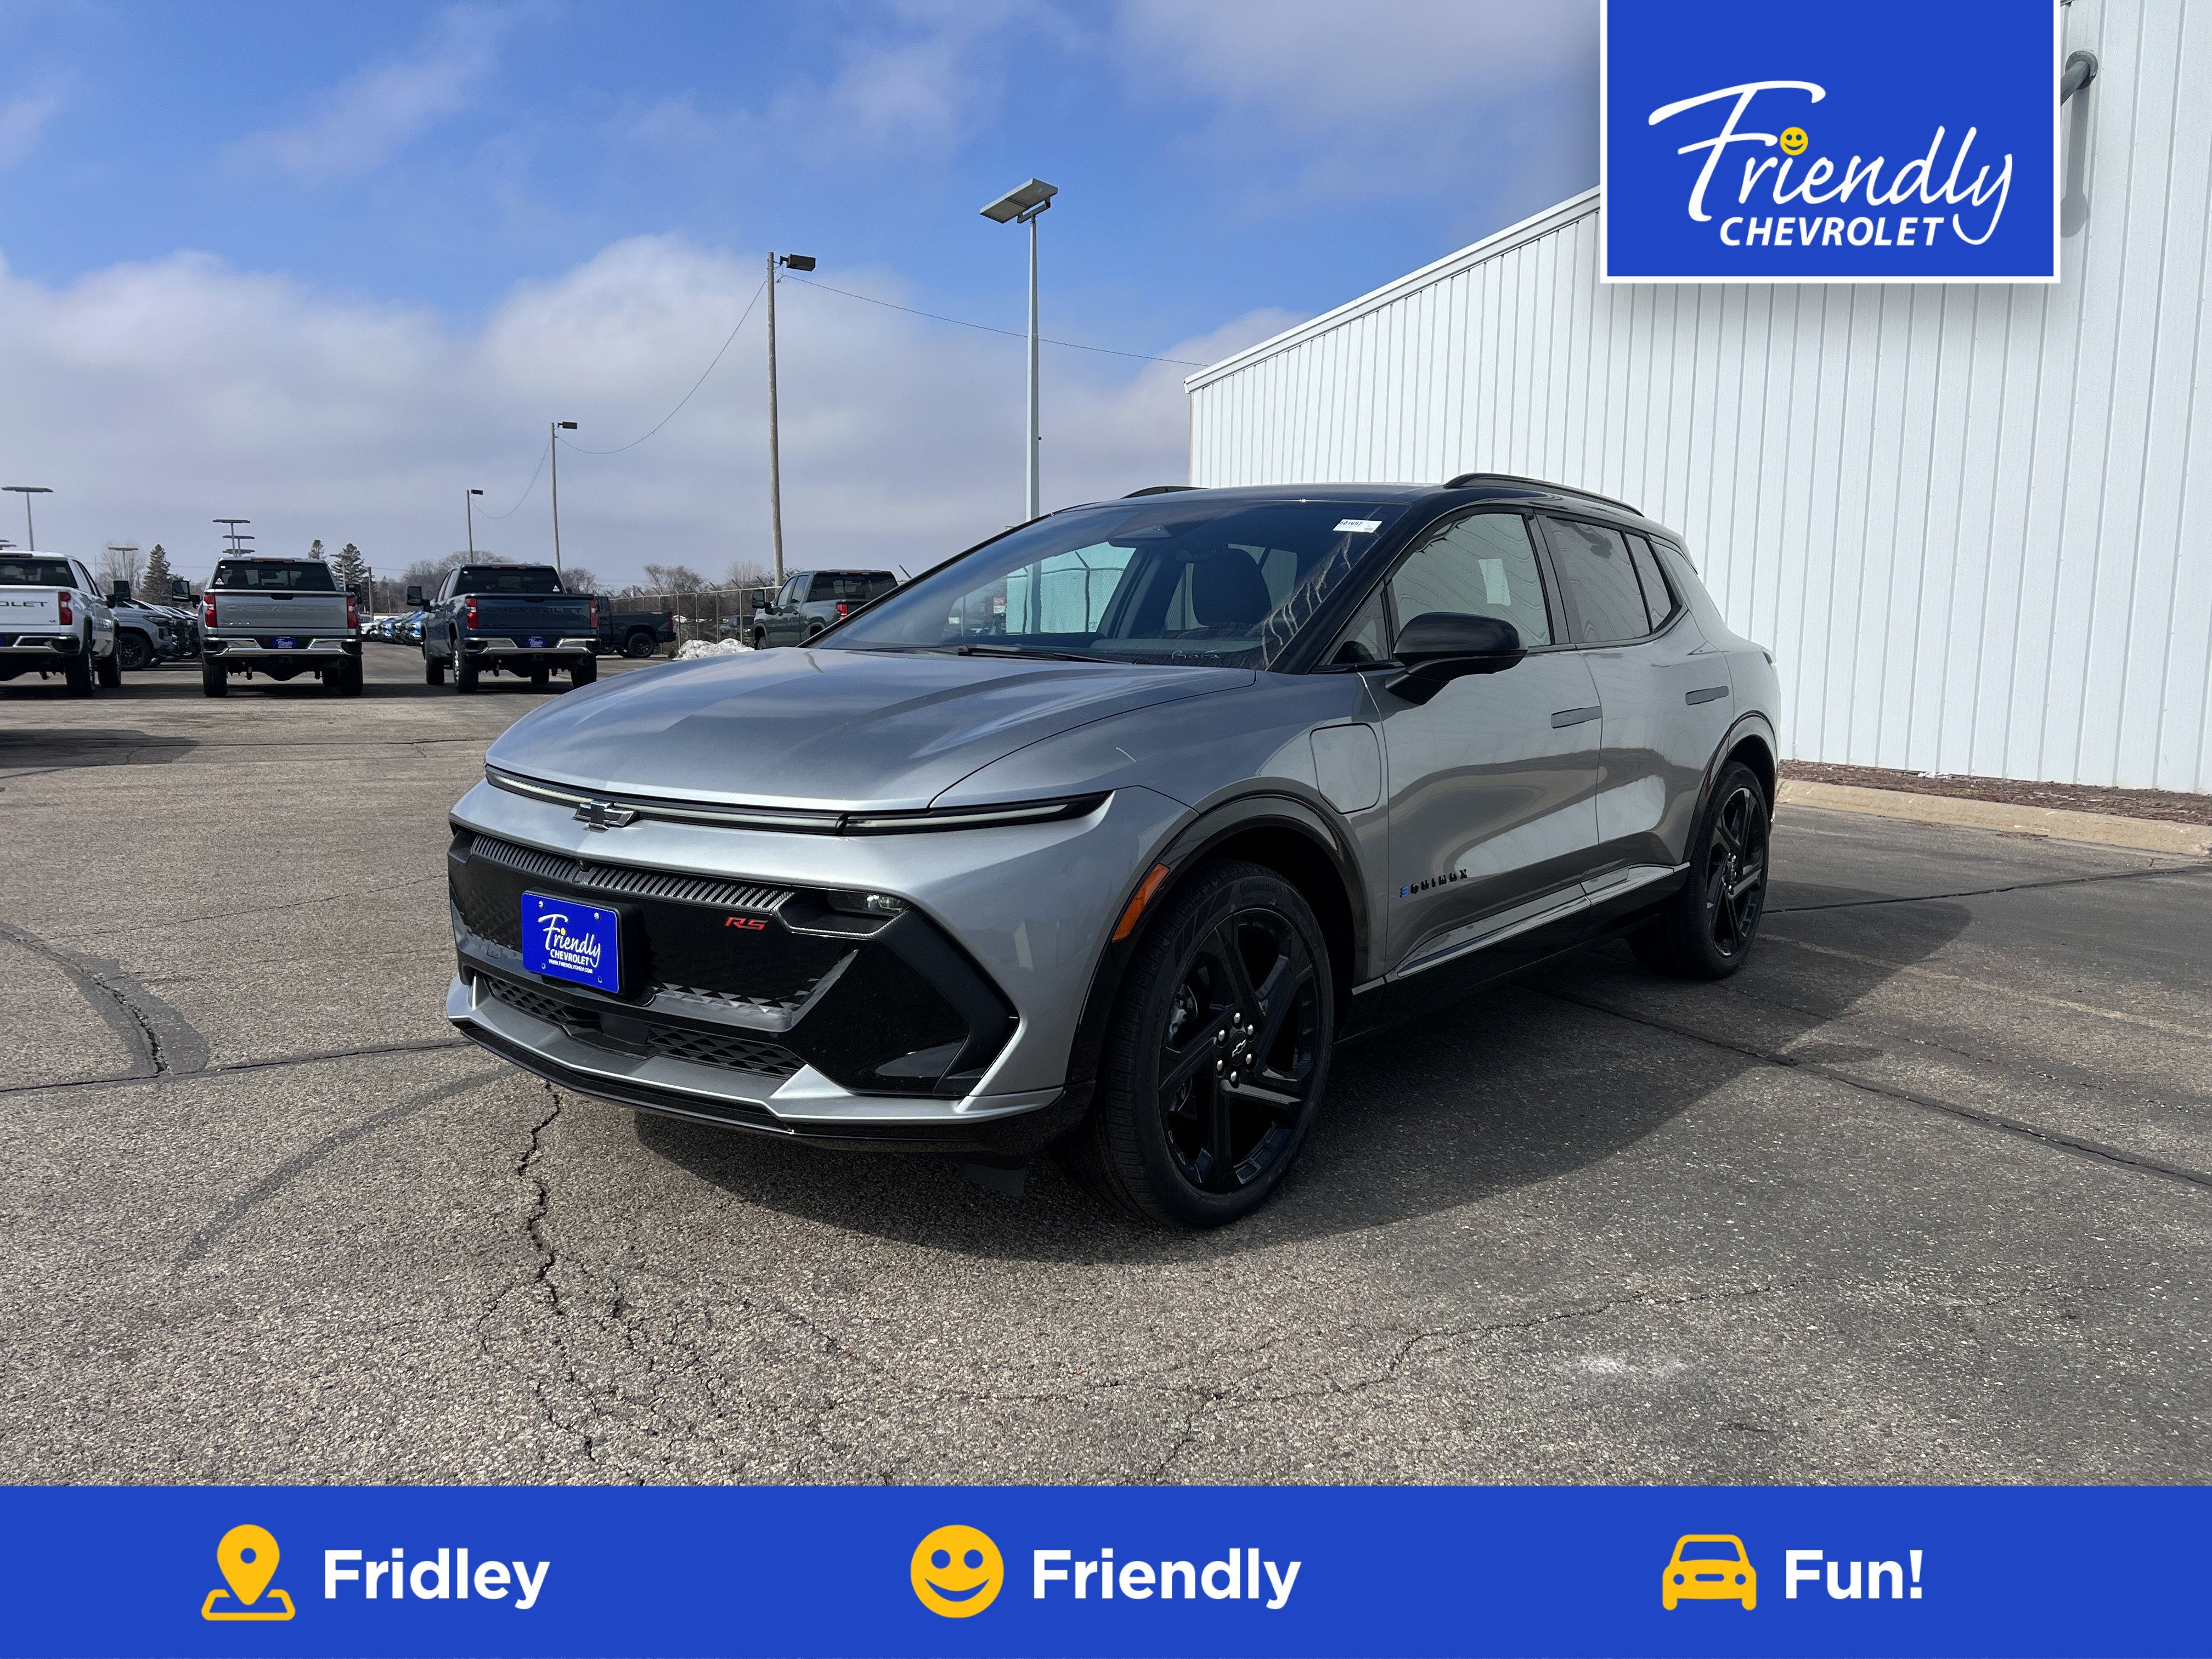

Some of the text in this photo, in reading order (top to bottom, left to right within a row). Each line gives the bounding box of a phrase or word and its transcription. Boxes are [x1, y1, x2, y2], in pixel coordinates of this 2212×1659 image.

[225, 604, 338, 612] CHEVROLET
[1239, 880, 1278, 896] Continental
[1400, 868, 1468, 898] EQUINOX
[724, 917, 769, 931] RS
[538, 913, 601, 968] Friendly
[550, 949, 590, 966] CHEVROLET
